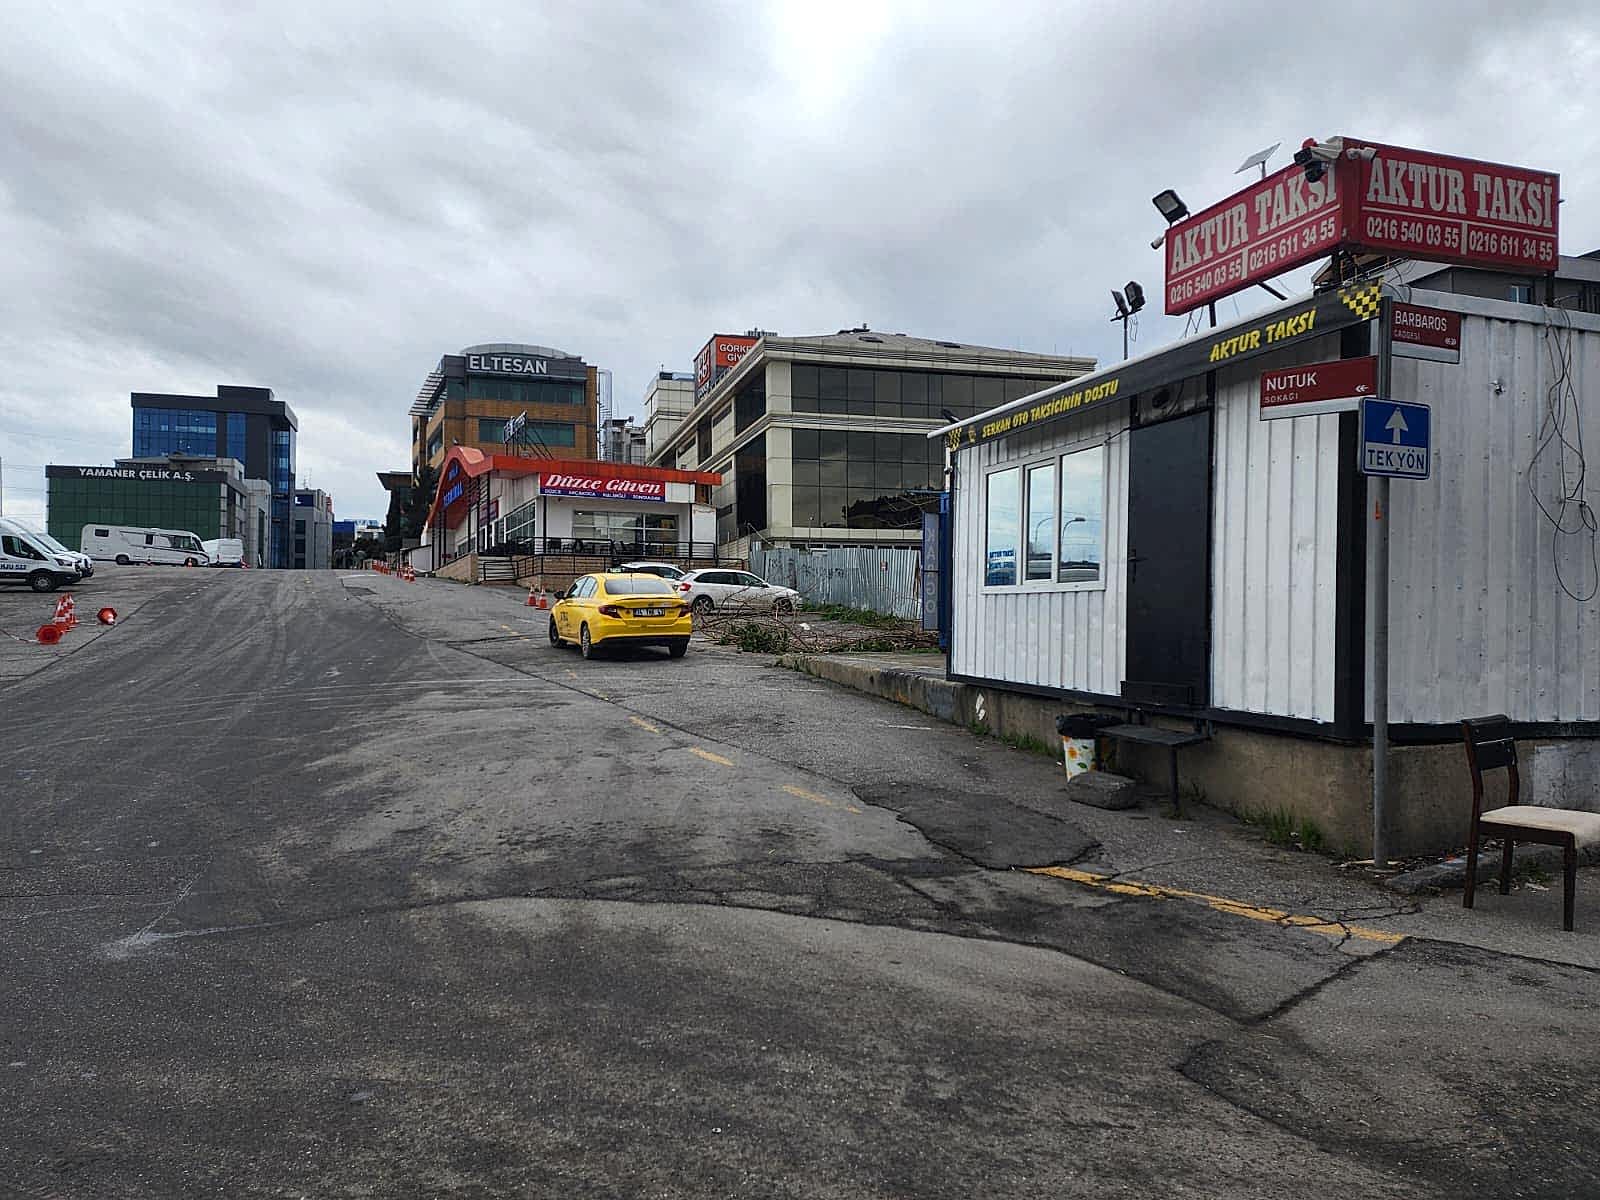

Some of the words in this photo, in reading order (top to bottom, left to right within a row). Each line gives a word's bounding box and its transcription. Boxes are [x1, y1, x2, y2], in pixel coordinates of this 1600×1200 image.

[1367, 158, 1467, 214] AKTUR
[1474, 173, 1552, 228] TAKSİ
[1171, 203, 1249, 275] AKTUR
[1250, 244, 1277, 271] 0216
[1279, 233, 1298, 259] 611
[1302, 224, 1317, 248] 34
[1320, 217, 1336, 241] 55
[1367, 217, 1397, 240] 0216
[1401, 221, 1423, 243] 540
[1426, 224, 1440, 245] 03
[1445, 227, 1460, 249] 55
[1469, 230, 1497, 253] 0216
[1500, 234, 1519, 257] 611
[1523, 239, 1537, 260] 34
[1539, 242, 1553, 261] 55
[1170, 280, 1193, 304] 0216
[1195, 272, 1212, 295] 540
[1214, 265, 1226, 285] 03
[1229, 260, 1242, 280] 55
[1395, 310, 1448, 332] BARBAROS
[1209, 330, 1261, 363] AKTUR
[1265, 306, 1317, 344] TAKSİ
[719, 343, 752, 353] GÖRKE
[727, 352, 746, 362] GİY
[469, 355, 547, 374] ELTESAN
[1266, 372, 1318, 392] NUTUK
[981, 417, 1011, 439] SERKAN
[1012, 412, 1029, 427] OTO
[1030, 390, 1082, 422] TAKSİCİNİN
[1084, 378, 1119, 404] DOSTU
[1367, 449, 1394, 468] TEK
[1397, 448, 1425, 470] YÖN
[79, 468, 135, 479] YAMANER
[139, 469, 170, 480] ÇELİK
[173, 472, 195, 482] A.Ş.
[545, 474, 602, 490] Düzce
[605, 479, 661, 494] Güven
